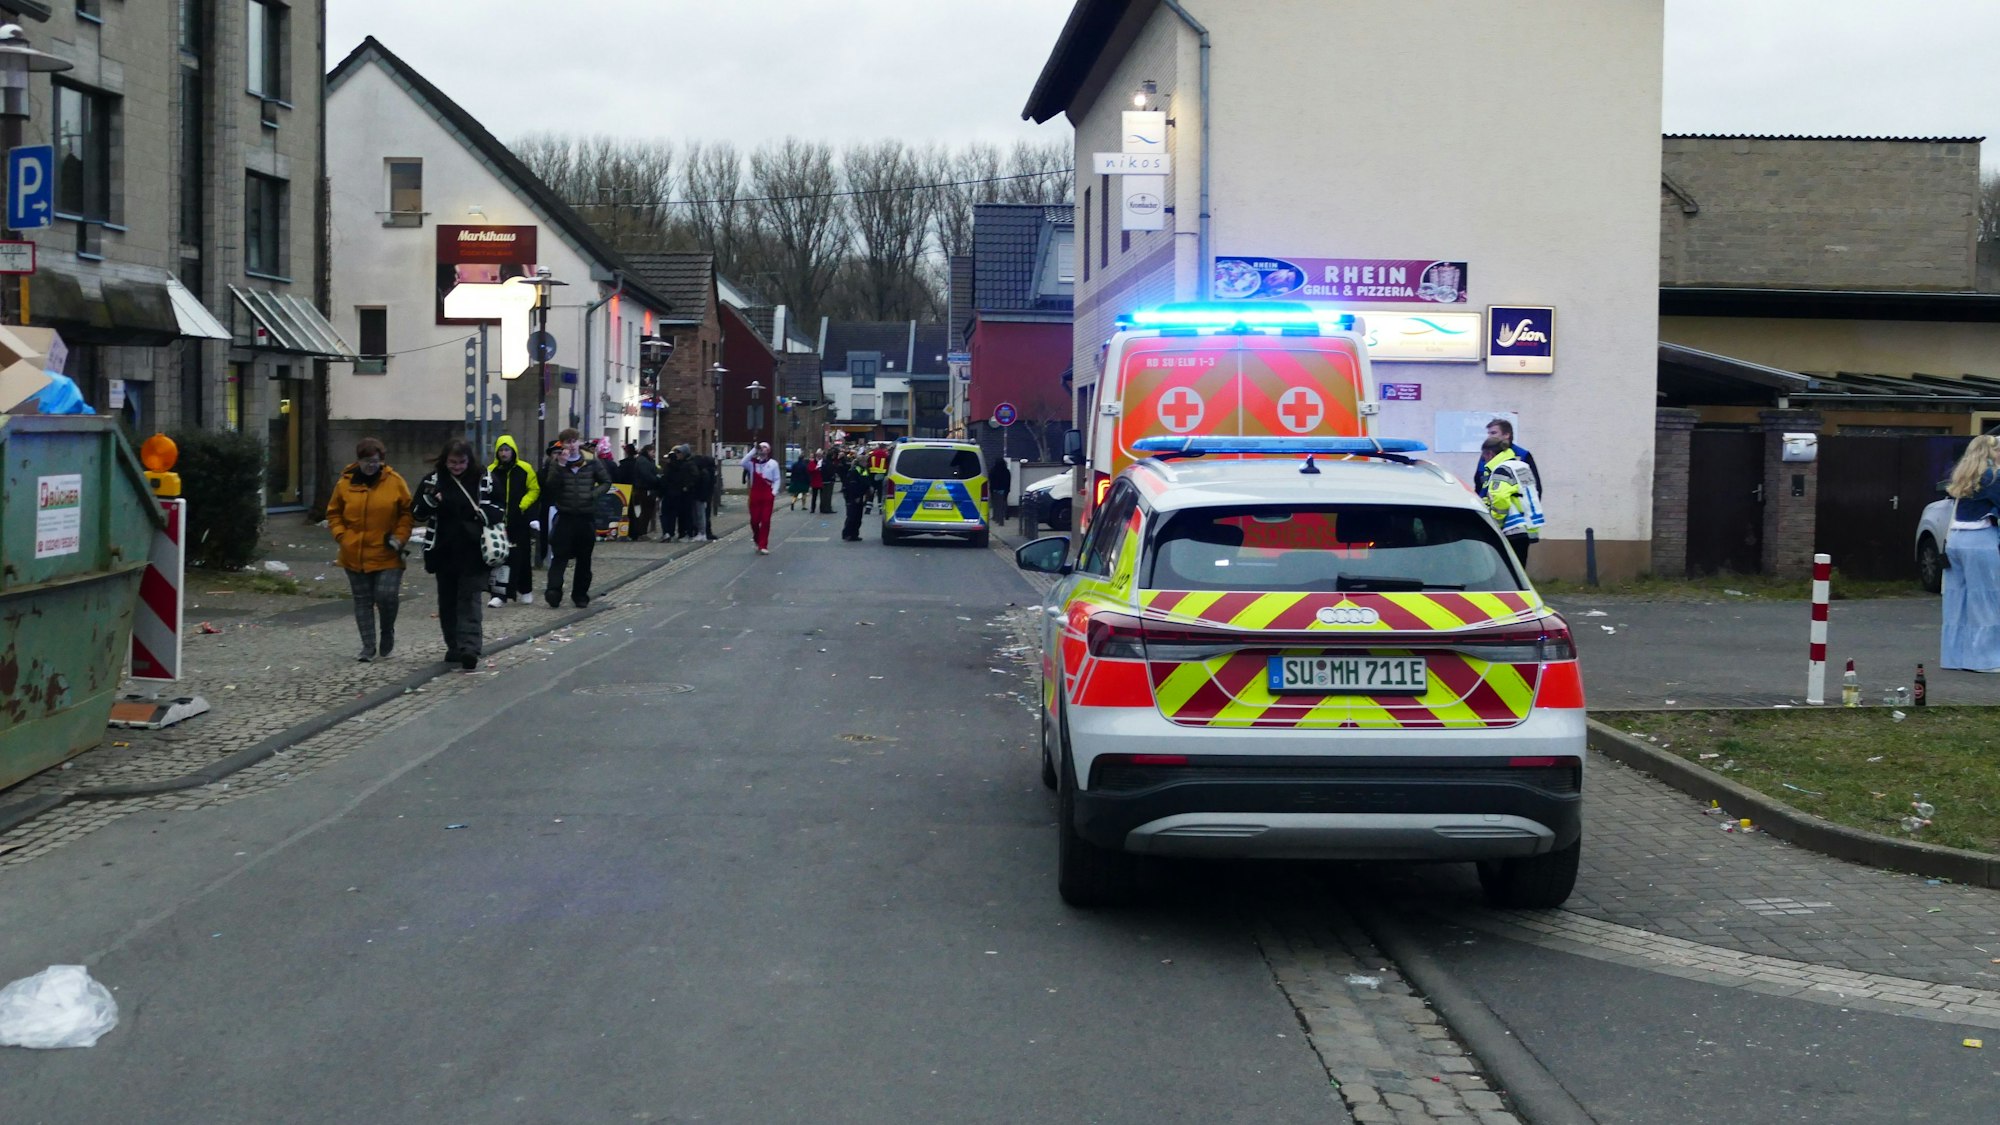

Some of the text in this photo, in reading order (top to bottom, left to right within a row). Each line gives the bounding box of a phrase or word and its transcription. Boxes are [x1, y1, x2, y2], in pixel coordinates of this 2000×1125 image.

[1106, 156, 1161, 168] nikos
[18, 157, 43, 219] P
[457, 230, 516, 242] Markthaus
[1325, 265, 1406, 285] RHEIN
[1303, 285, 1414, 297] GRILL & PIZZERIA
[1495, 318, 1547, 348] Sion
[1286, 660, 1423, 685] SU MH 711E
